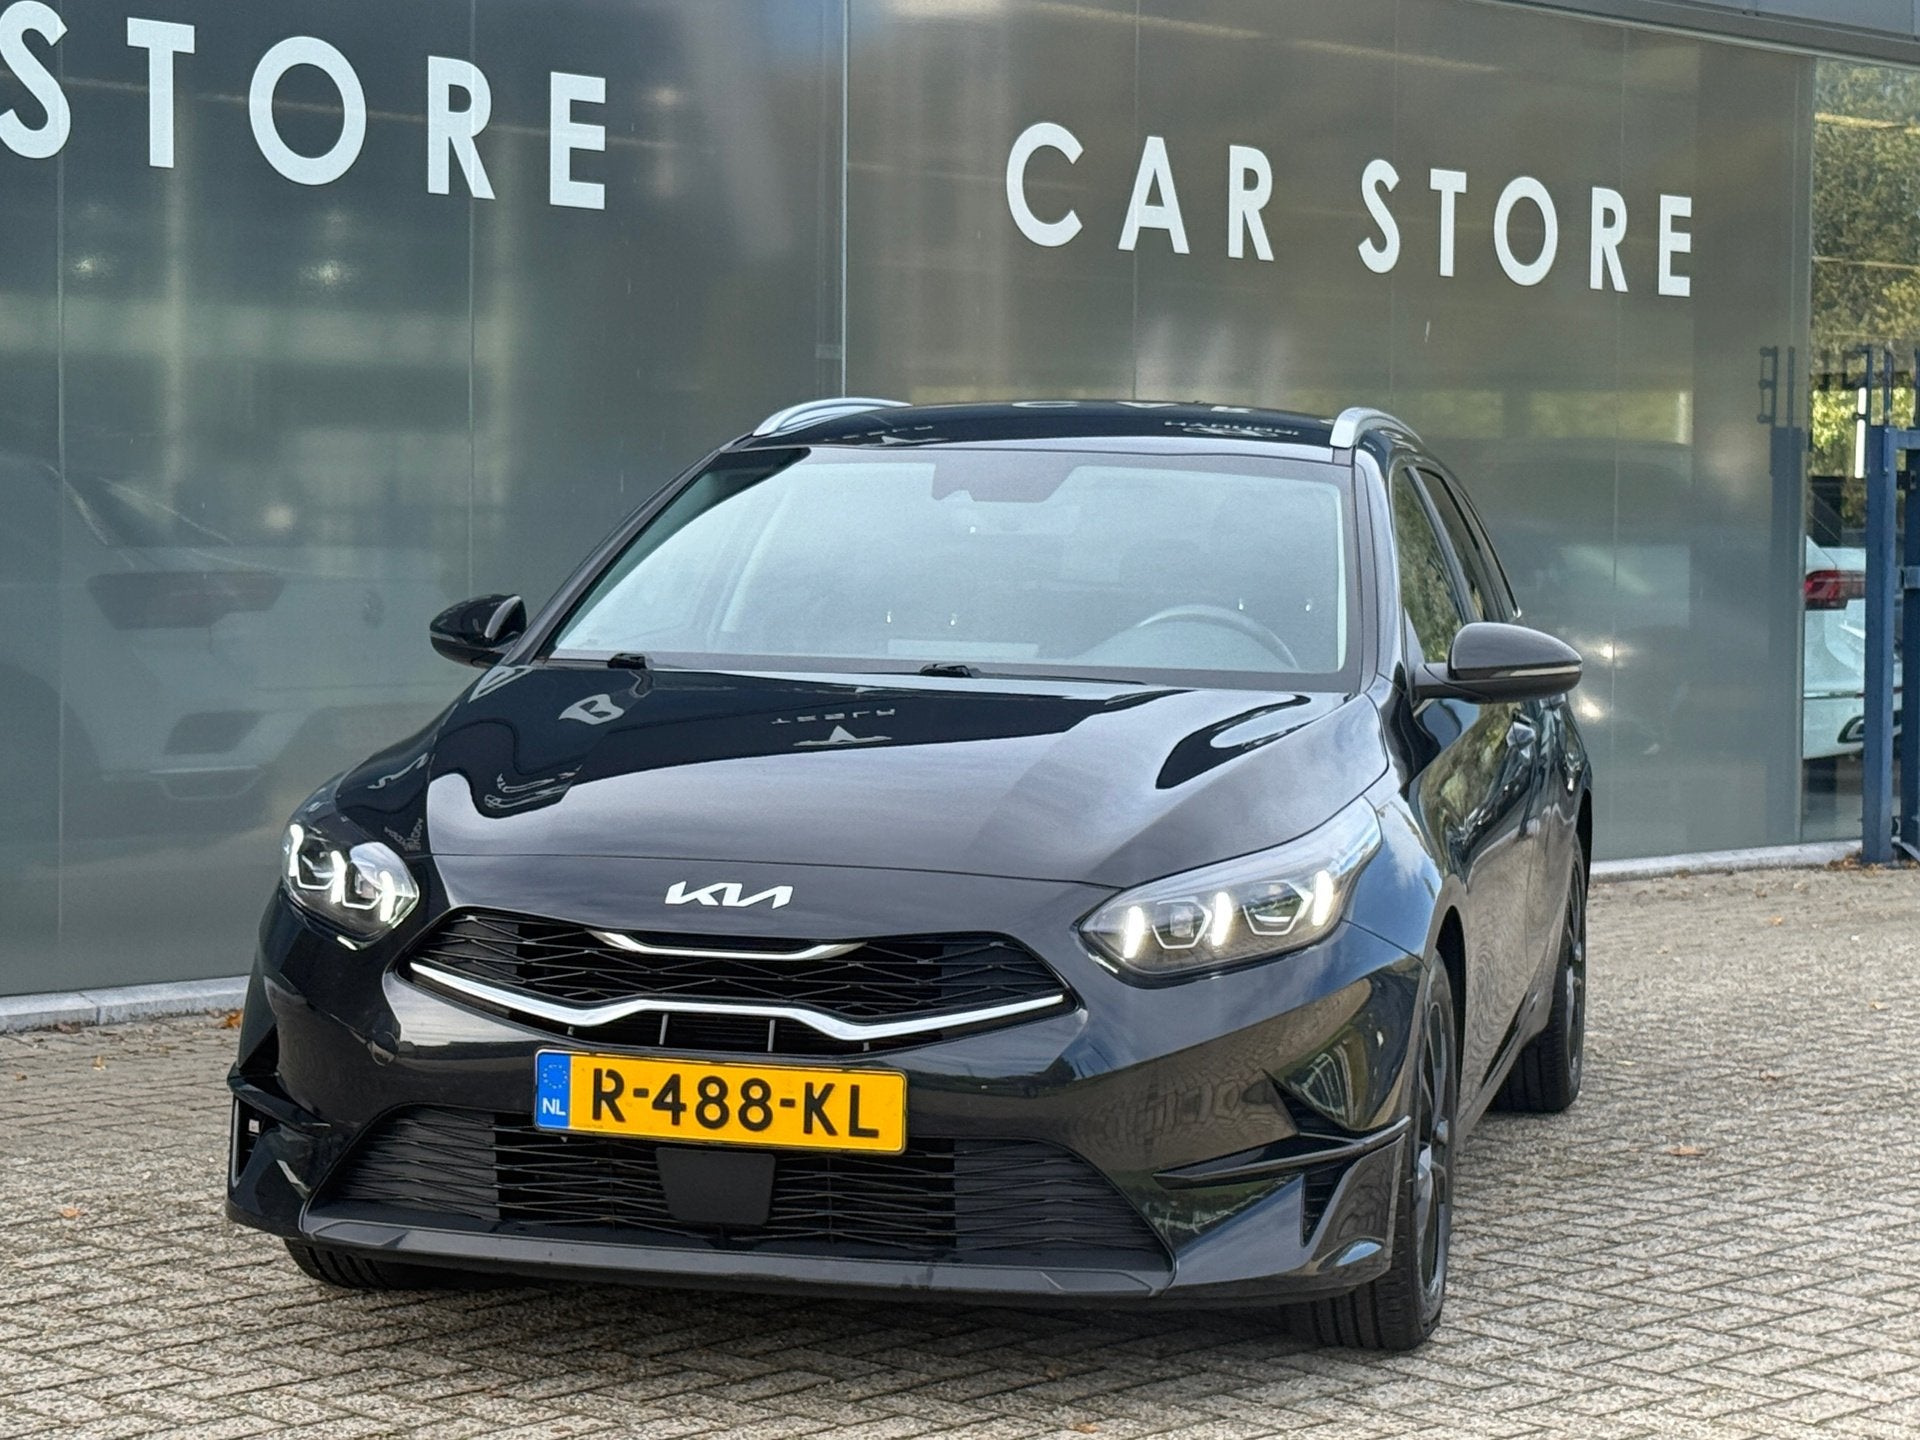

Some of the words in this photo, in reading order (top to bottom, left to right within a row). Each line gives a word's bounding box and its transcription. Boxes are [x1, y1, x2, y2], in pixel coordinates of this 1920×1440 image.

[0, 0, 606, 210] STORE
[1006, 122, 1274, 262] CAR
[1358, 158, 1692, 297] STORE
[664, 880, 794, 909] KIA
[542, 1097, 566, 1116] NL
[591, 1067, 880, 1139] R-488-KL
